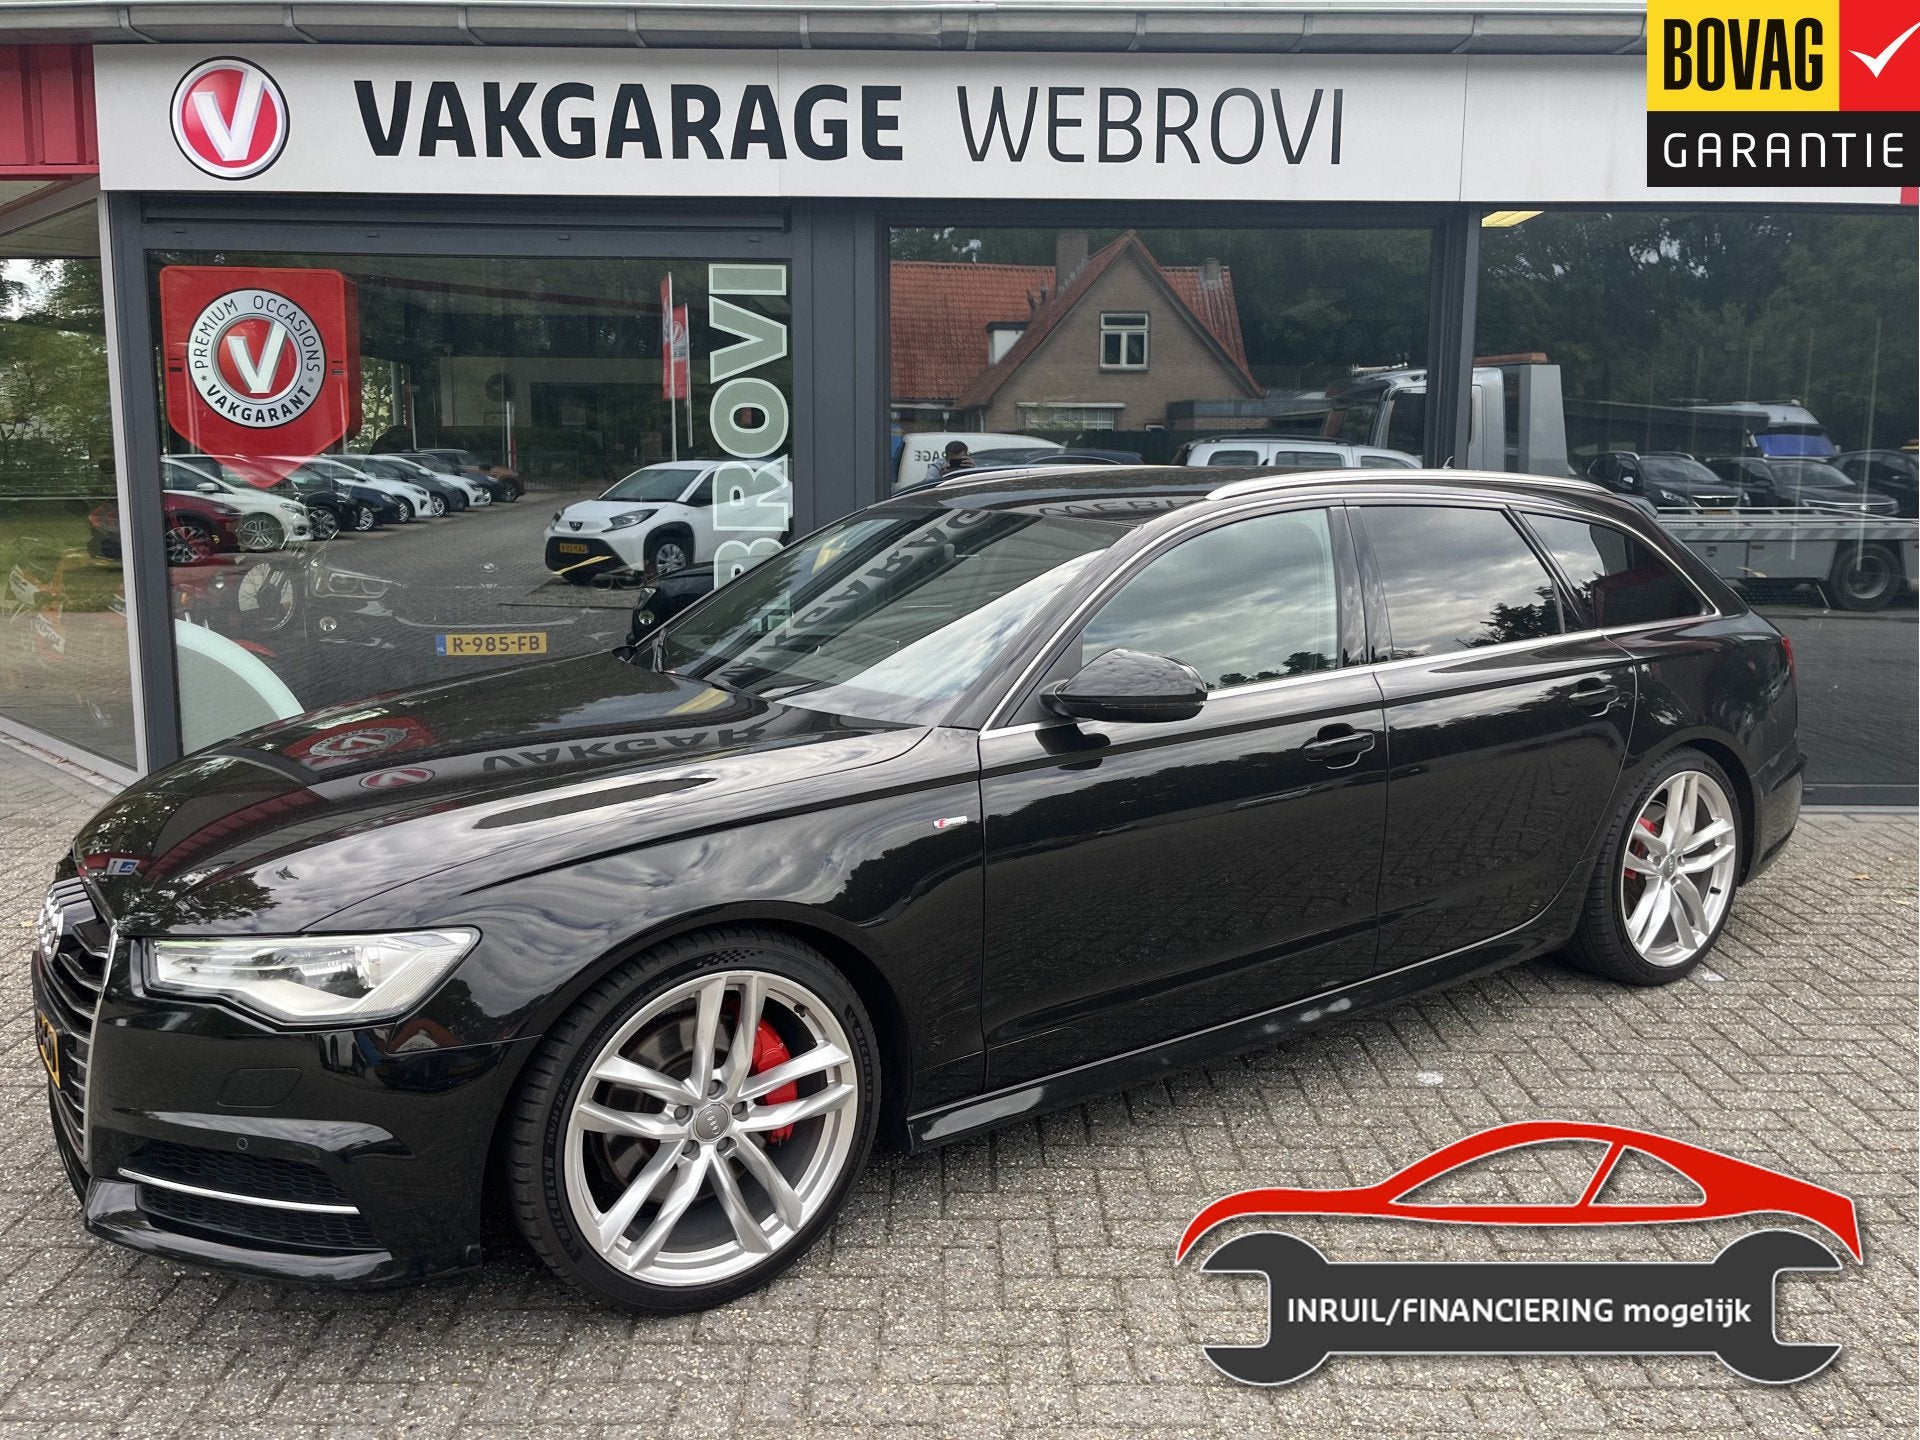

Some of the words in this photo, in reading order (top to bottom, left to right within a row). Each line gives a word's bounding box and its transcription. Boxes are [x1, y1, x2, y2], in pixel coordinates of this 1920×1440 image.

[354, 80, 904, 161] VAKGARAGE
[956, 86, 1345, 166] WEBROVI
[193, 298, 239, 370] PREMIUM
[253, 295, 321, 373] OCCASIONS
[206, 384, 312, 423] VAKGARANT
[452, 635, 541, 653] R-985-FB
[854, 1027, 873, 1103] MICHELIN
[544, 1156, 573, 1241] MICHELIN
